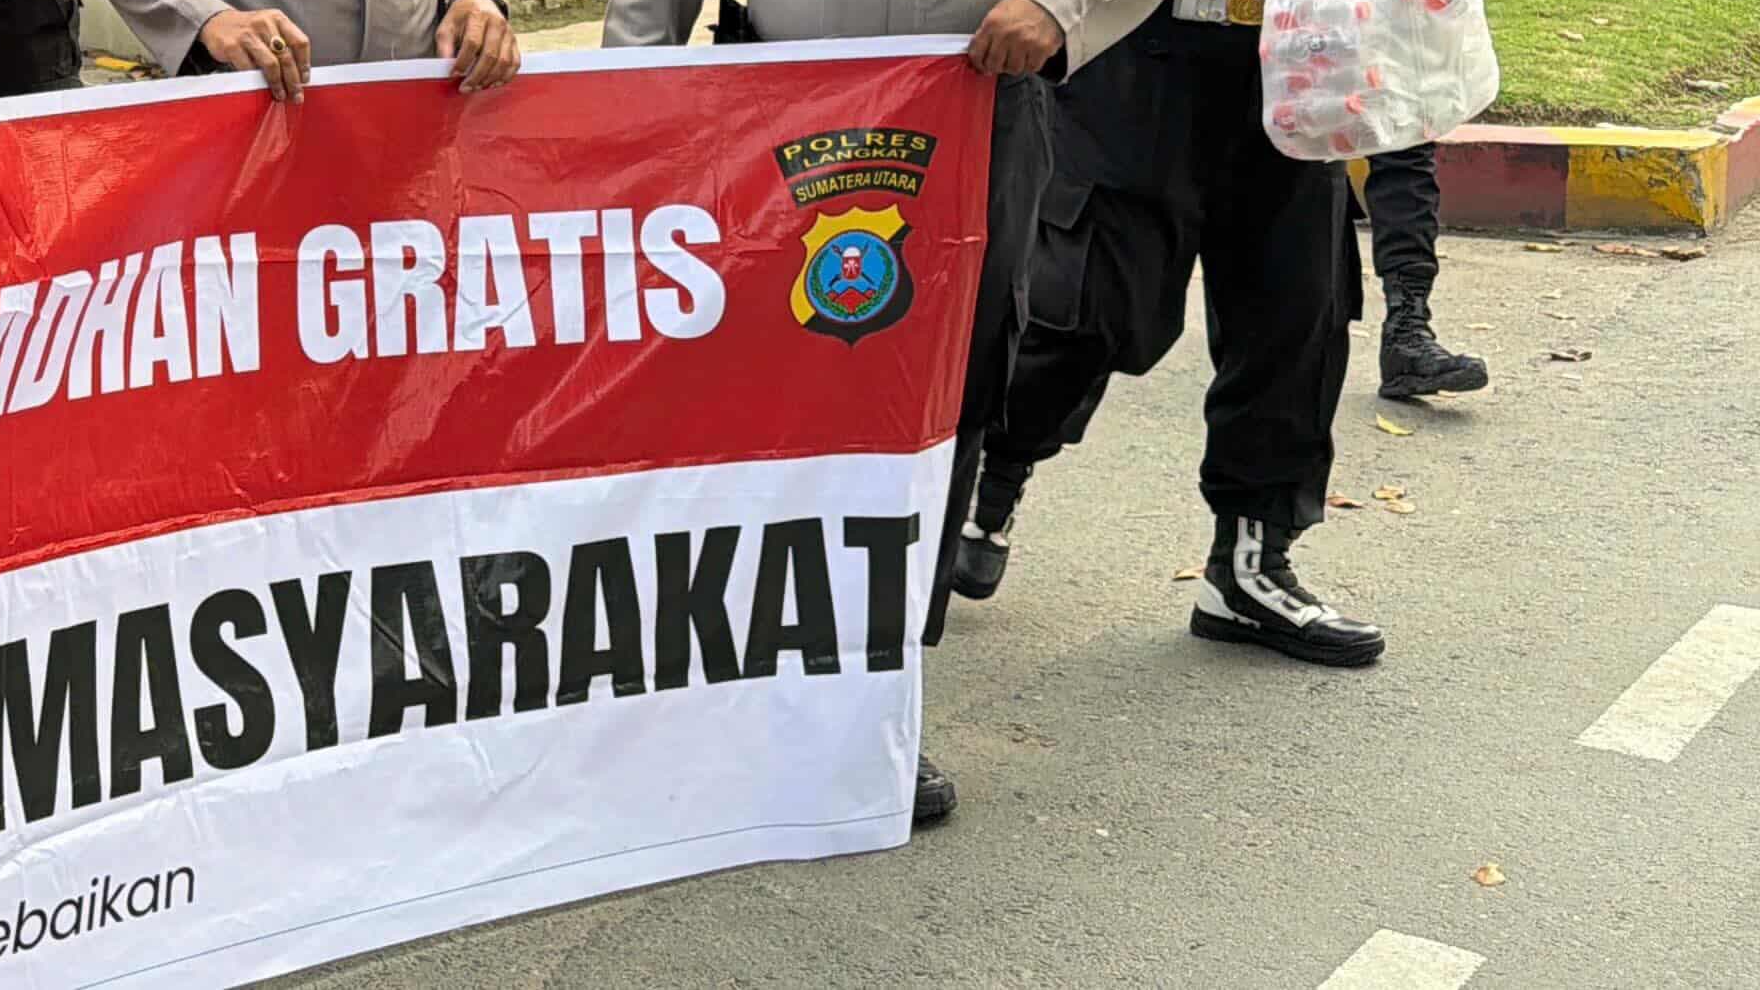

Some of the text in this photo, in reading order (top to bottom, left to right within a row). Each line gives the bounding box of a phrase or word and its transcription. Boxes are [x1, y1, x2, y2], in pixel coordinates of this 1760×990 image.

[783, 132, 927, 160] POLRES
[803, 148, 910, 168] LANGKAT
[795, 170, 917, 202] SUMATERA UTARA
[297, 204, 726, 364] GRATIS
